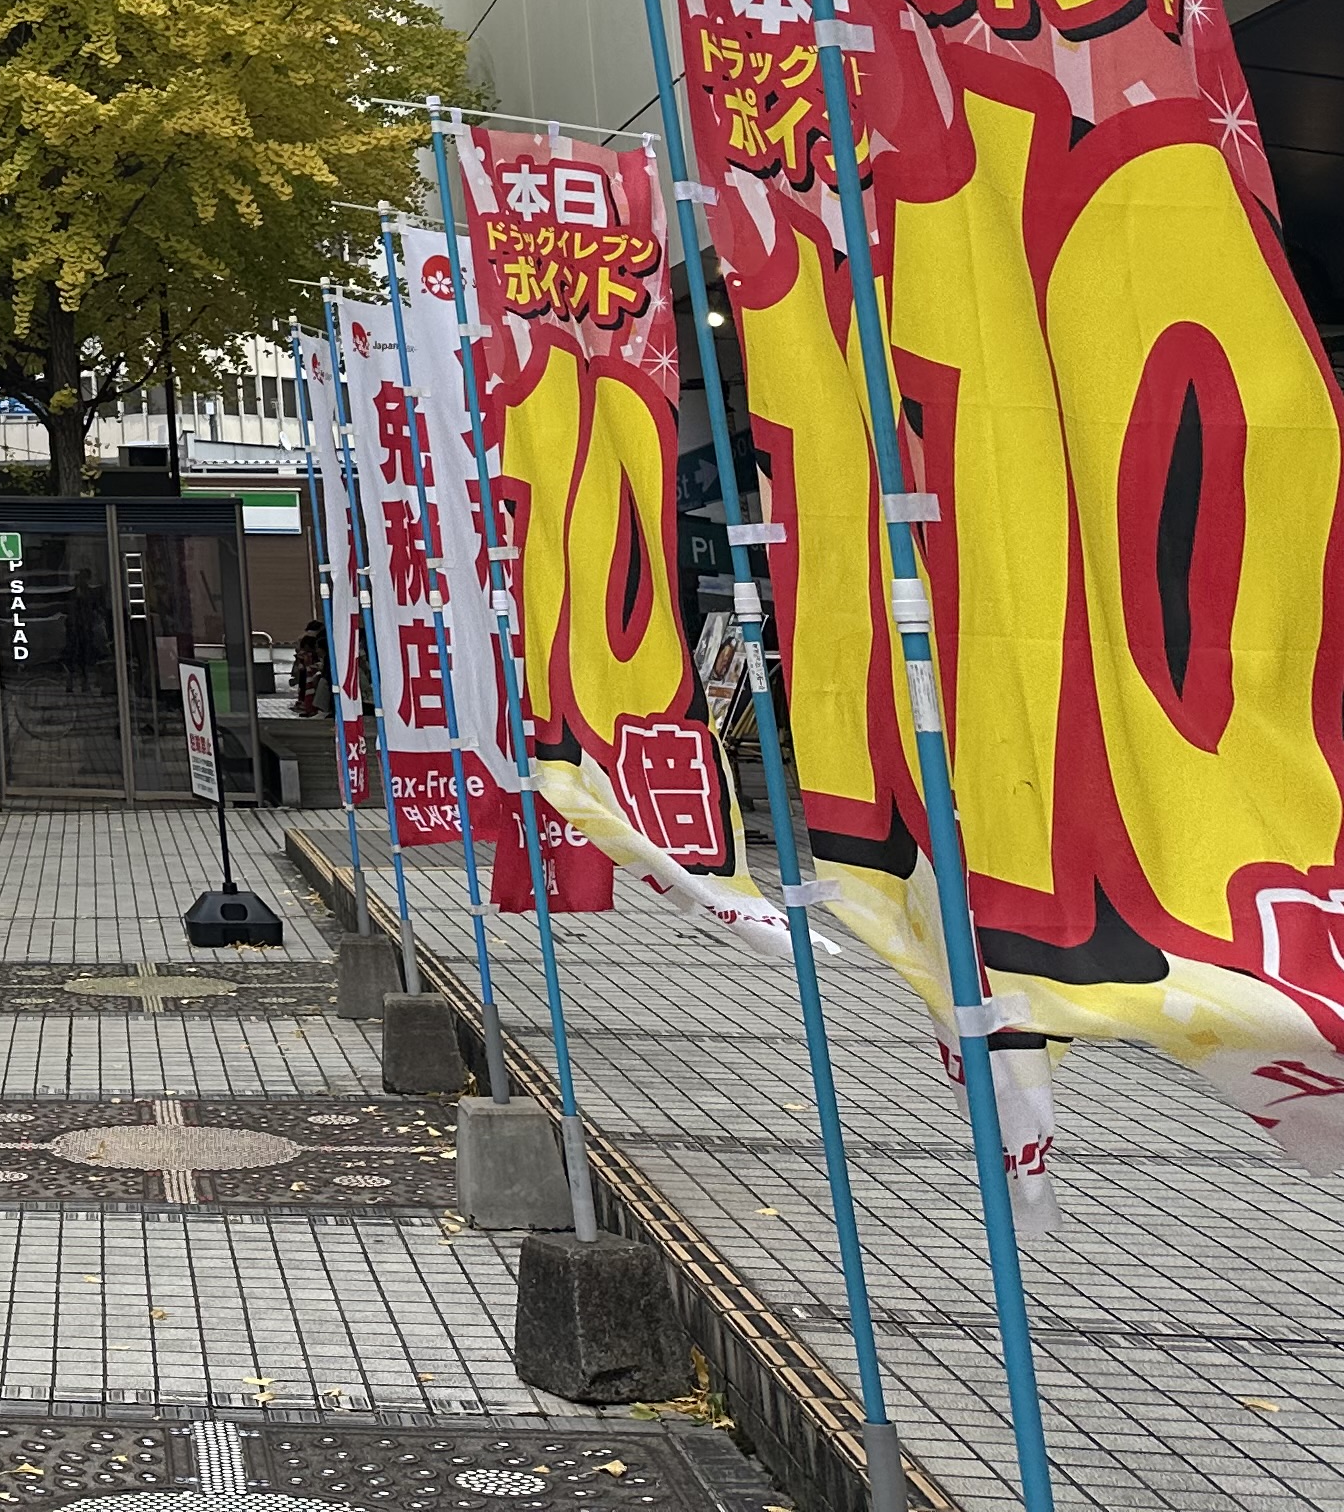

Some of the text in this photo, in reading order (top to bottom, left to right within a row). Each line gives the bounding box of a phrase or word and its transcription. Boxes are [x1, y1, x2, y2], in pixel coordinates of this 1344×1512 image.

[502, 164, 608, 228] 本日
[486, 221, 654, 264] ドラッグイレブン
[503, 256, 638, 316] ポイント
[372, 378, 455, 729] 免税店
[501, 345, 683, 746] 10
[892, 88, 1341, 941] 10
[10, 580, 29, 660] SALAD
[391, 770, 485, 799] ax-Free
[617, 723, 719, 855] 倍
